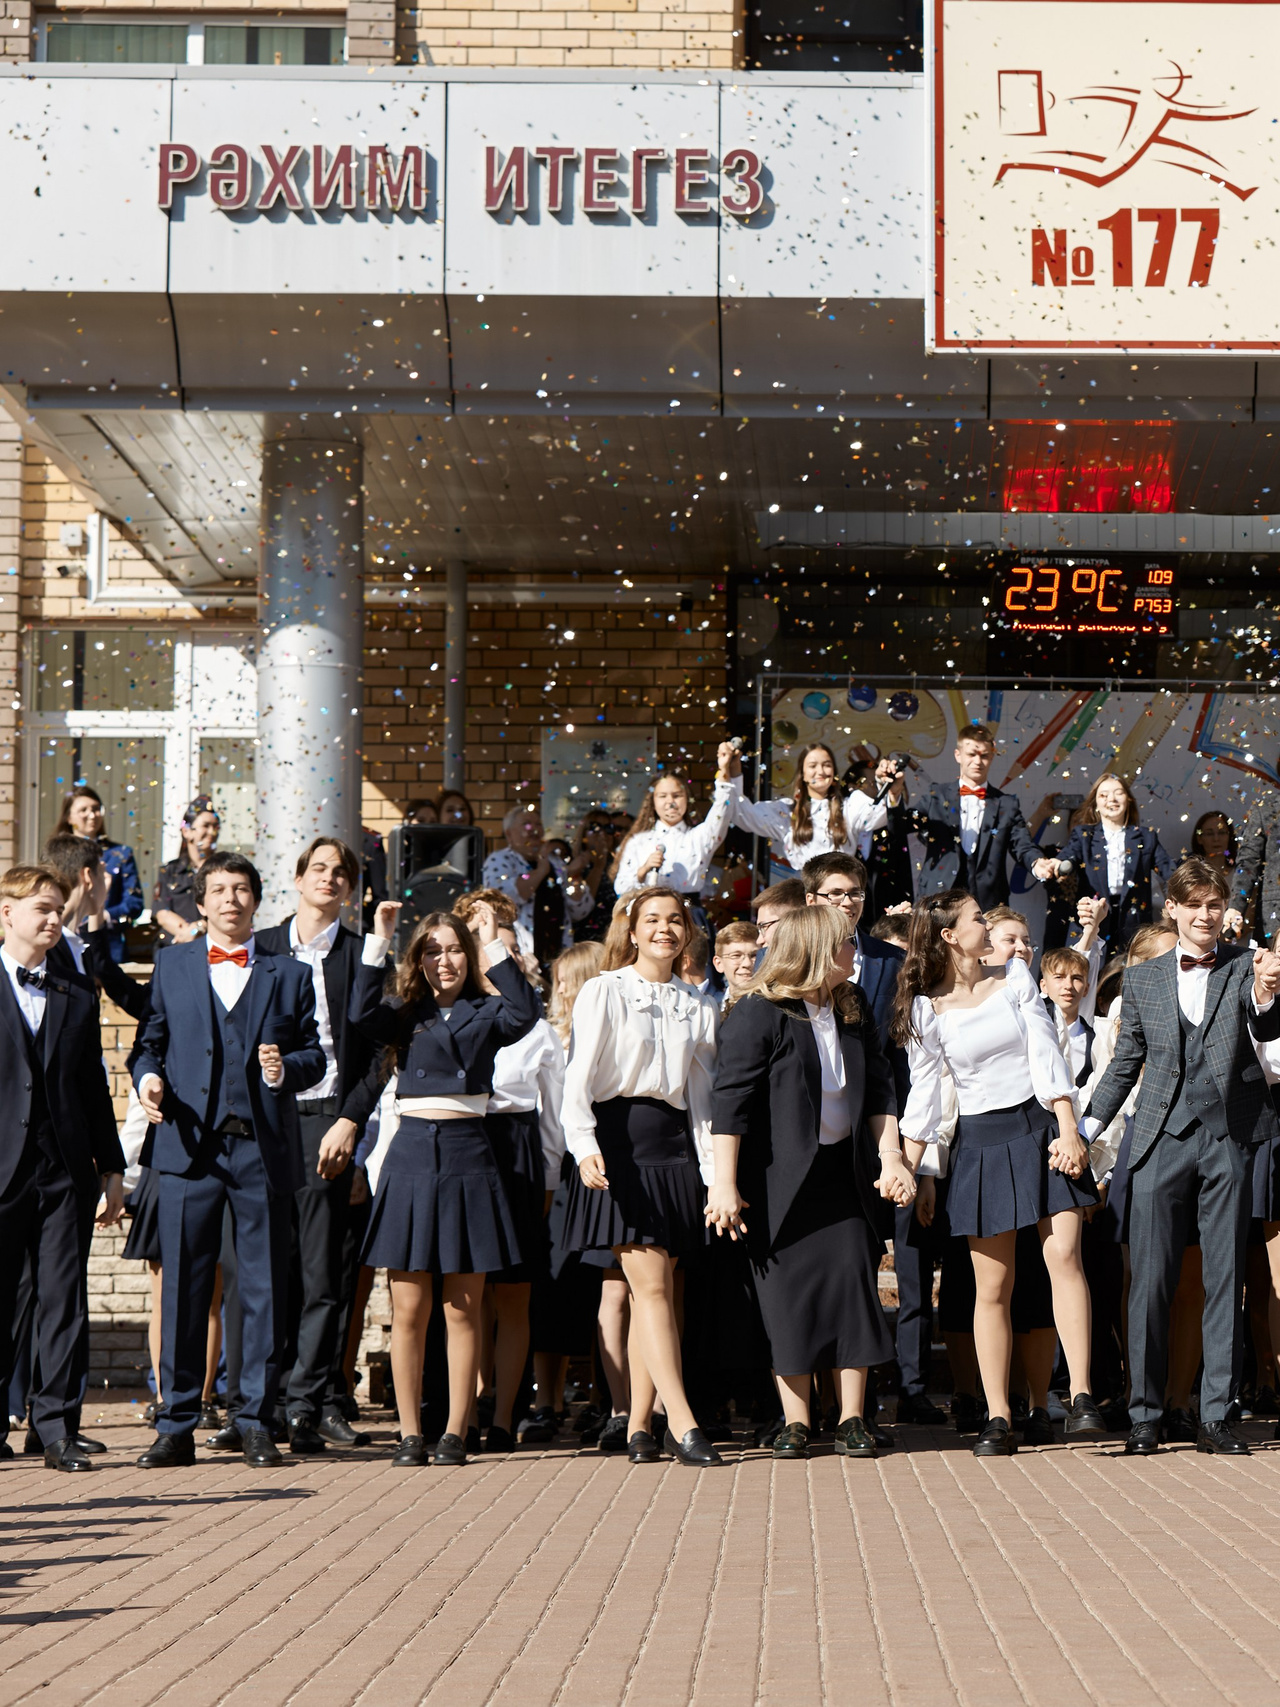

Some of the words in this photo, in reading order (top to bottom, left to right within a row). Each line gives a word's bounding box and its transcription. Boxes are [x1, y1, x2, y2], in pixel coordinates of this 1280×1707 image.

[157, 142, 428, 212] РӘХИМ
[484, 145, 765, 216] ИТЕГЕЗ
[1054, 558, 1111, 566] ТЕЕРАТУРА
[1147, 570, 1174, 585] 1.09
